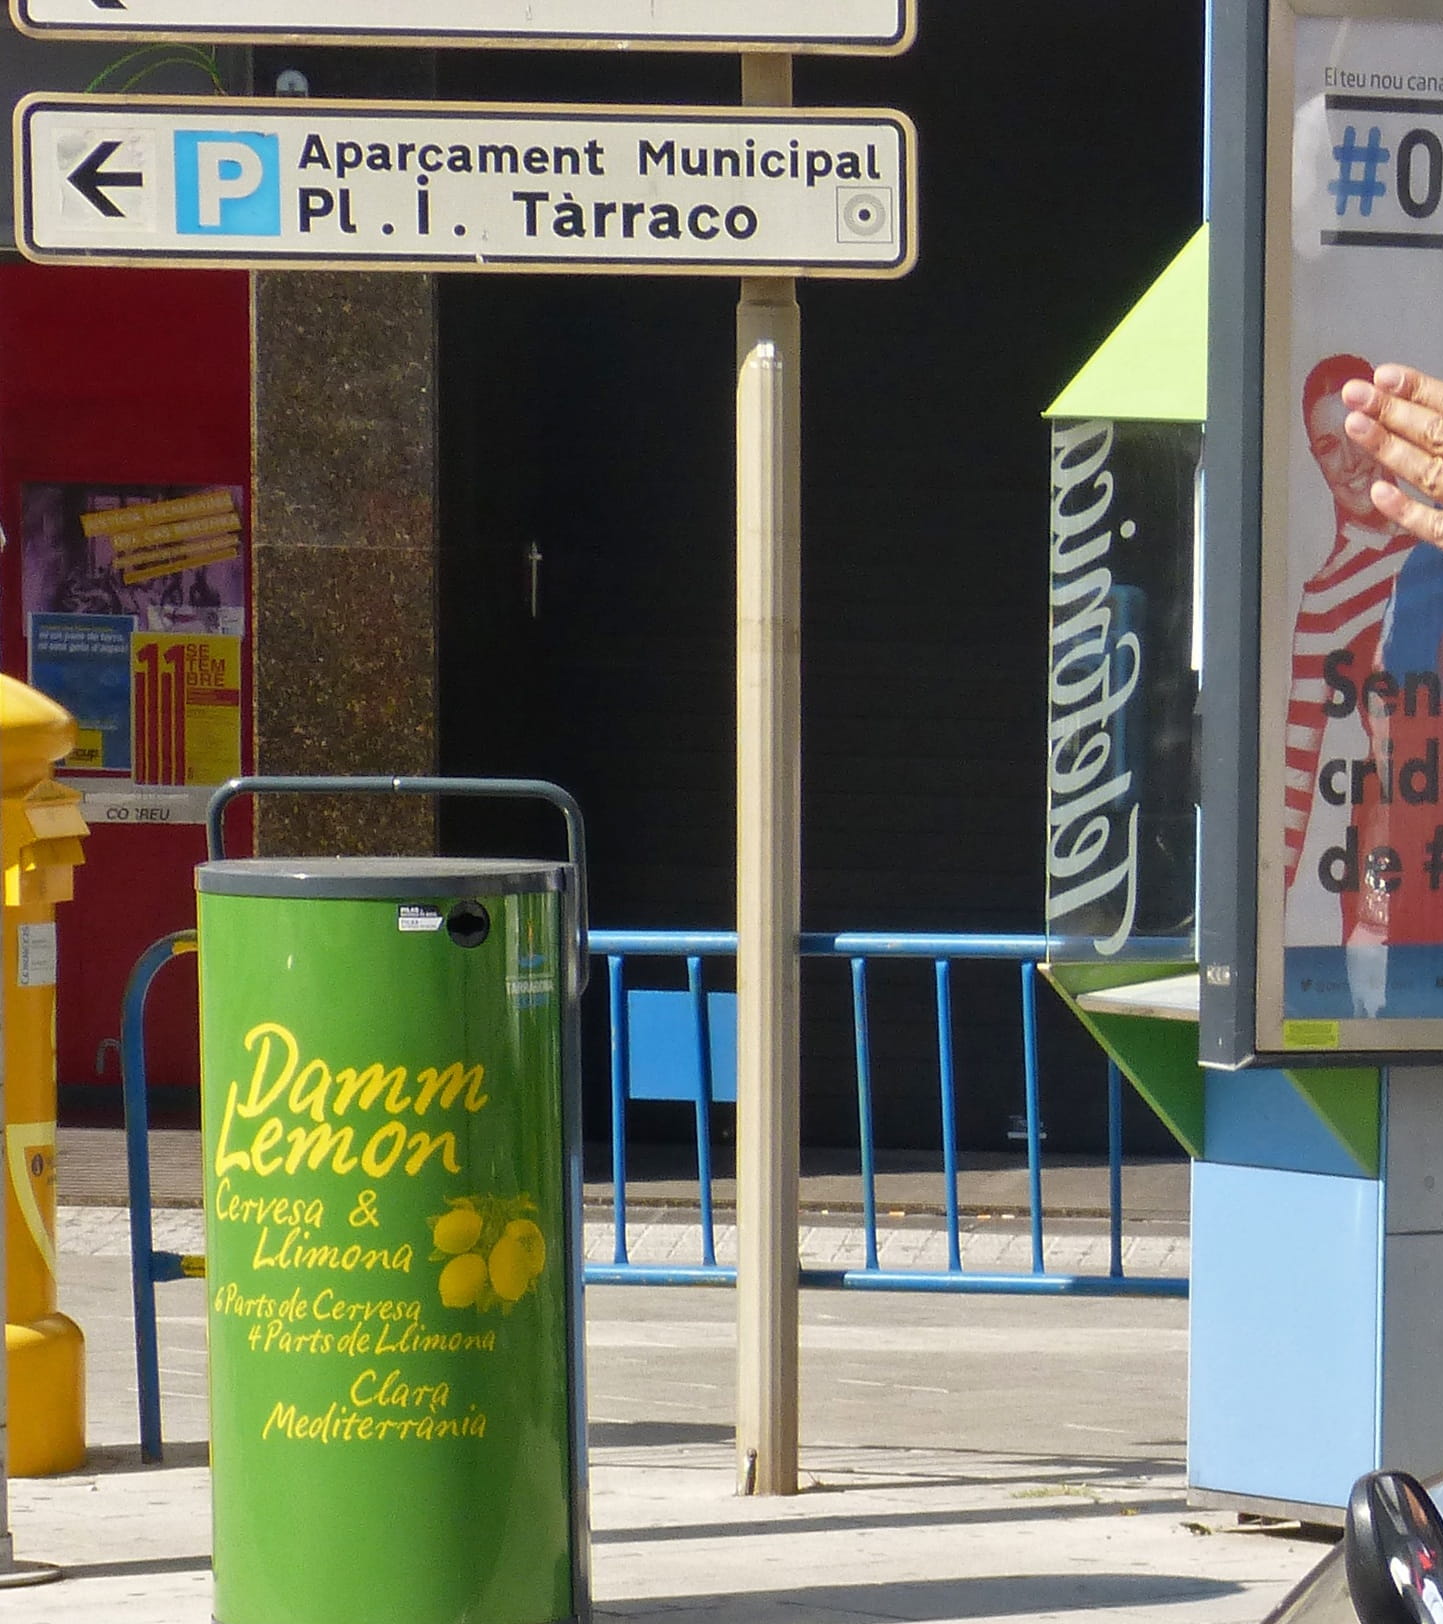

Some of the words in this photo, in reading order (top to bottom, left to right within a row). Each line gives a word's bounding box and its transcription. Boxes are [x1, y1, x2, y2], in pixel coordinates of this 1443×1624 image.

[1325, 67, 1337, 88] El
[1339, 71, 1366, 89] teu
[1369, 71, 1402, 91] nou
[297, 134, 605, 180] Aparçament
[638, 138, 882, 186] Municipal
[513, 188, 760, 241] Tàrraco
[1317, 822, 1402, 896] de
[237, 1022, 489, 1119] Damm
[216, 1081, 461, 1179] Lemon
[216, 1182, 325, 1228] Cervesa
[350, 1189, 380, 1227] &
[252, 1225, 415, 1272] Llimona
[313, 1289, 423, 1321] Cervesa
[248, 1325, 262, 1352] 4
[264, 1319, 331, 1353] Parts
[334, 1319, 370, 1358] de
[375, 1322, 497, 1355] Llimona
[350, 1368, 449, 1408] Clara
